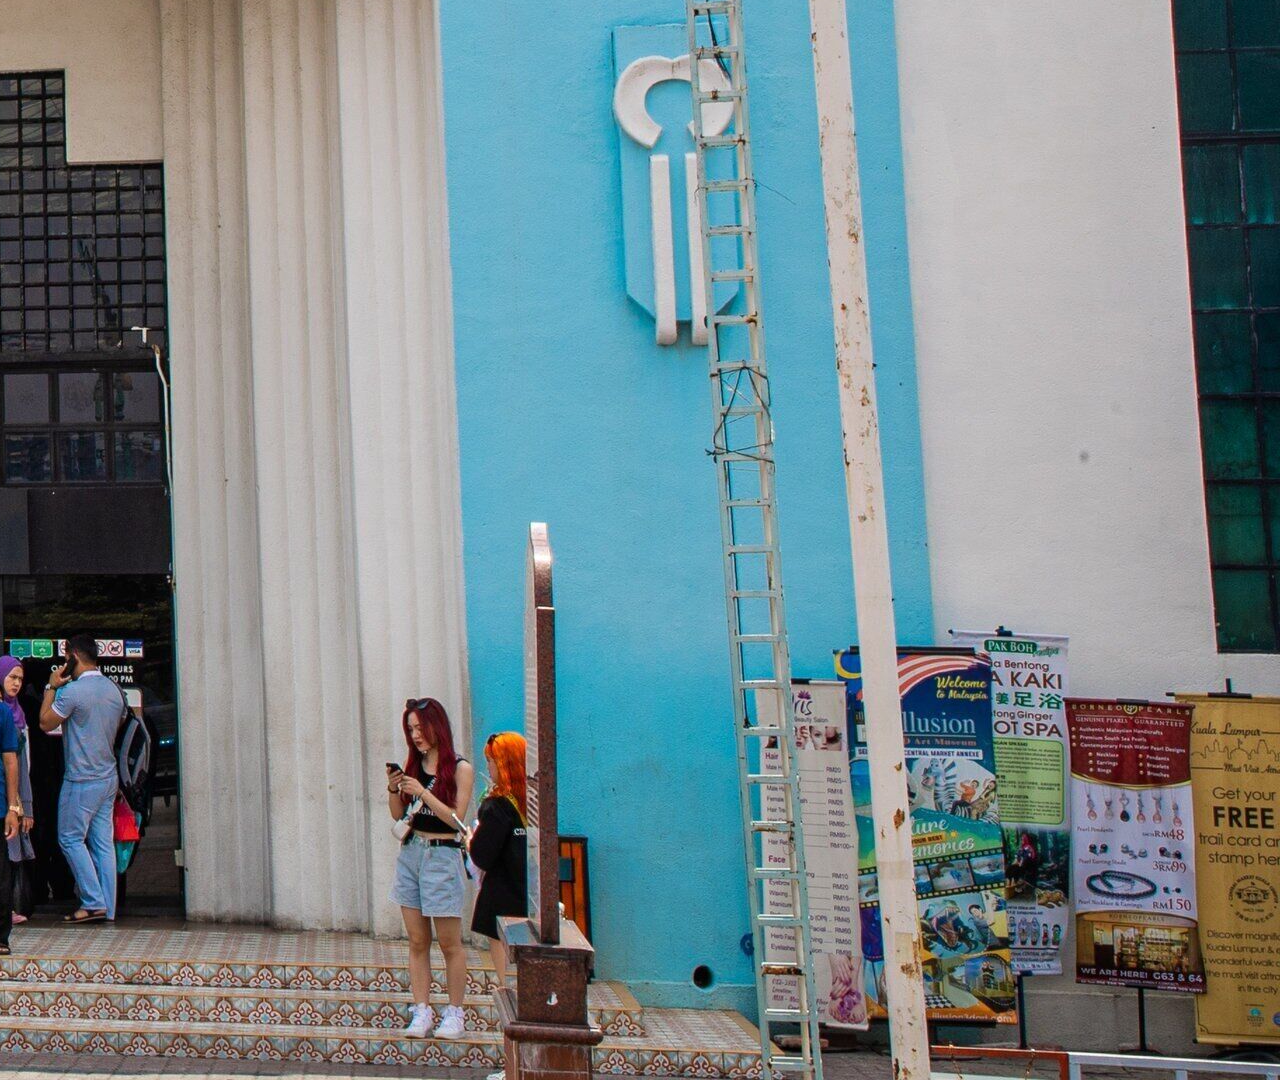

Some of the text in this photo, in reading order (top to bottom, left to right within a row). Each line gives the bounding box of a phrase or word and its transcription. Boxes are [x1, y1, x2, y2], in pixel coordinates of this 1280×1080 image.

[988, 640, 1008, 652] PAK
[1010, 641, 1033, 653] BOH
[103, 665, 134, 673] HOURS
[1004, 660, 1050, 673] Bentong
[120, 675, 134, 683] PM
[935, 675, 987, 688] Welcome
[1010, 671, 1062, 689] KAKI
[936, 688, 989, 702] to Malaysia
[1016, 710, 1053, 721] Ginger
[1138, 705, 1191, 716] PEARLS
[1023, 721, 1063, 738] SPA
[1134, 718, 1185, 728] GUARANTEED
[1220, 722, 1261, 738] Lumpur
[915, 737, 931, 745] Art
[935, 737, 977, 746] Museum
[1080, 742, 1118, 750] Contemporary
[1165, 746, 1186, 754] Designs
[765, 752, 779, 760] Hair
[1212, 786, 1276, 803] Get your
[1213, 805, 1275, 829] FREE
[1154, 828, 1185, 841] RM48
[1199, 831, 1224, 845] trail
[1226, 834, 1262, 847] card
[768, 855, 786, 864] Face
[1208, 851, 1255, 867] stamp
[1152, 898, 1192, 912] RM150
[1207, 929, 1244, 939] Discover
[1206, 944, 1232, 953] Kuala
[1233, 945, 1266, 955] Lumpur
[1208, 958, 1275, 968] wonderful walk
[1080, 967, 1096, 975] WE
[1120, 970, 1148, 979] HERE!
[1153, 972, 1174, 981] G63
[1178, 973, 1185, 981] &
[1188, 974, 1203, 983] 64
[1222, 970, 1243, 979] must
[1246, 983, 1262, 992] the
[1262, 985, 1279, 996] city
